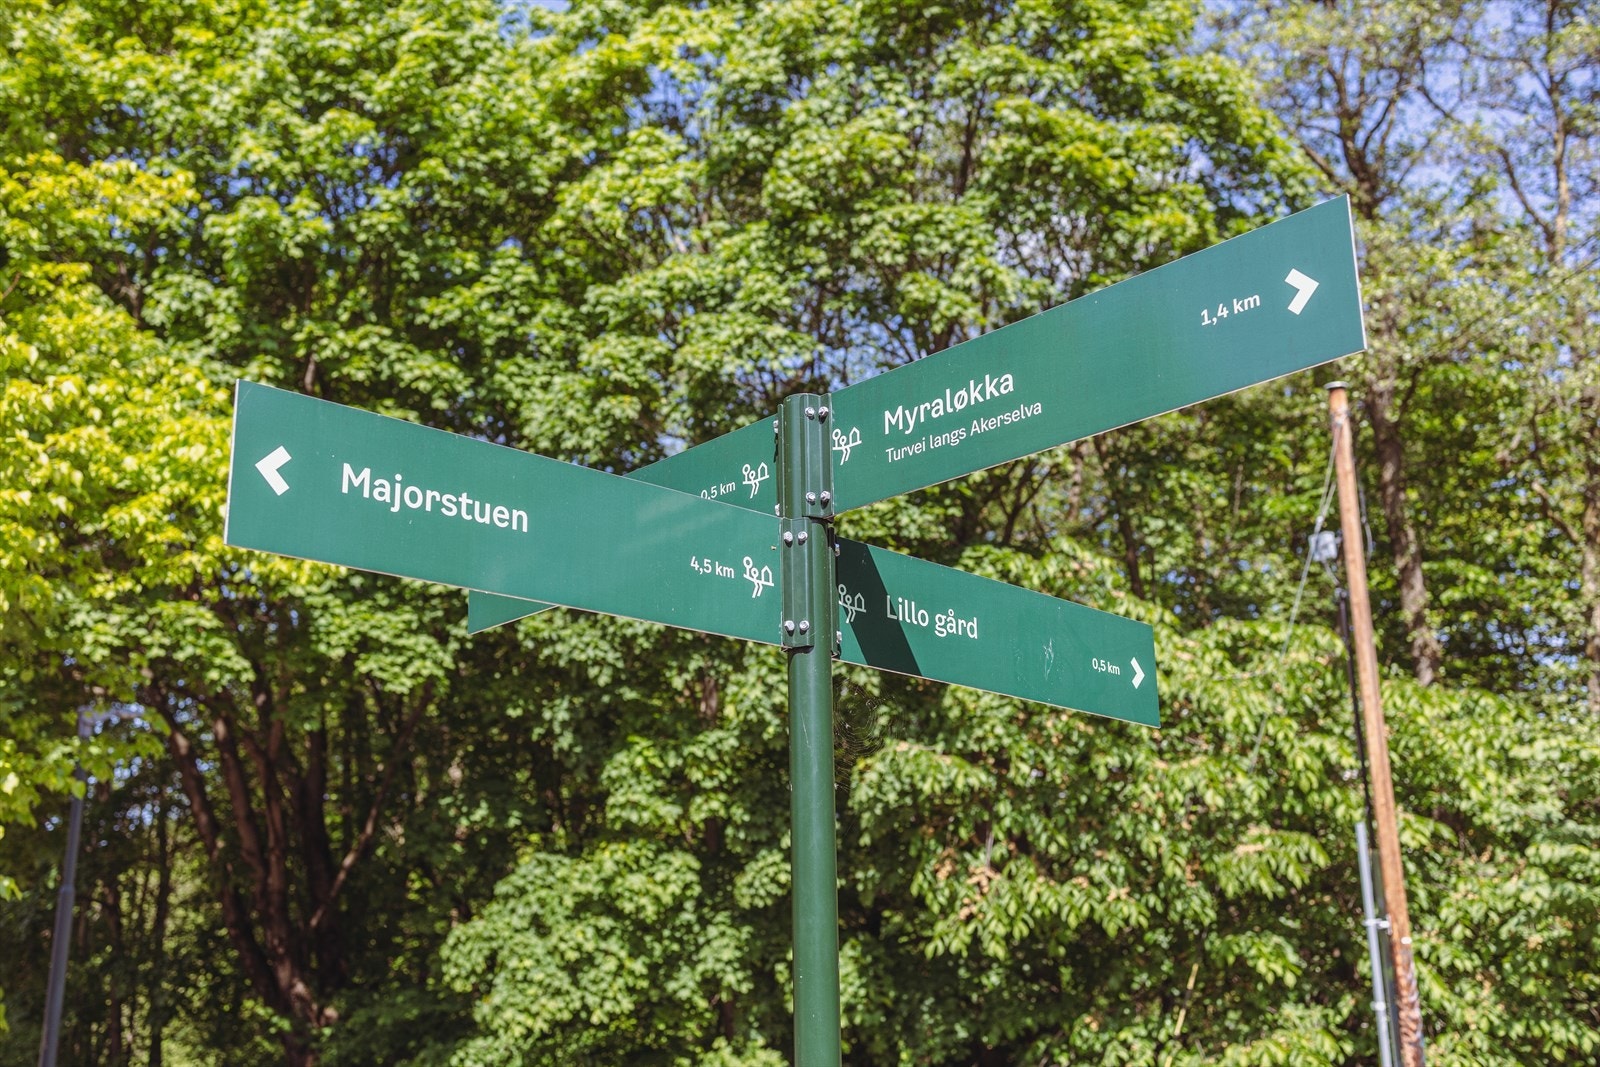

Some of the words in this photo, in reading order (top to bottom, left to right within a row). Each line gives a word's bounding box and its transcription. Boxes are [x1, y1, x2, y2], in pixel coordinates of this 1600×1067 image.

[1200, 303, 1229, 326] 1,4
[1232, 294, 1261, 315] km
[884, 373, 1013, 434] Myraløkka
[886, 439, 926, 463] Turvei
[929, 427, 966, 450] langs
[970, 402, 1042, 436] Akerselva
[341, 462, 529, 533] Majorstuen
[720, 481, 736, 496] km
[690, 556, 712, 575] 4,5
[715, 561, 735, 579] km
[886, 594, 929, 627] Lillo
[934, 608, 979, 640] gård
[1092, 657, 1107, 673] 0,5
[1107, 661, 1121, 676] km
